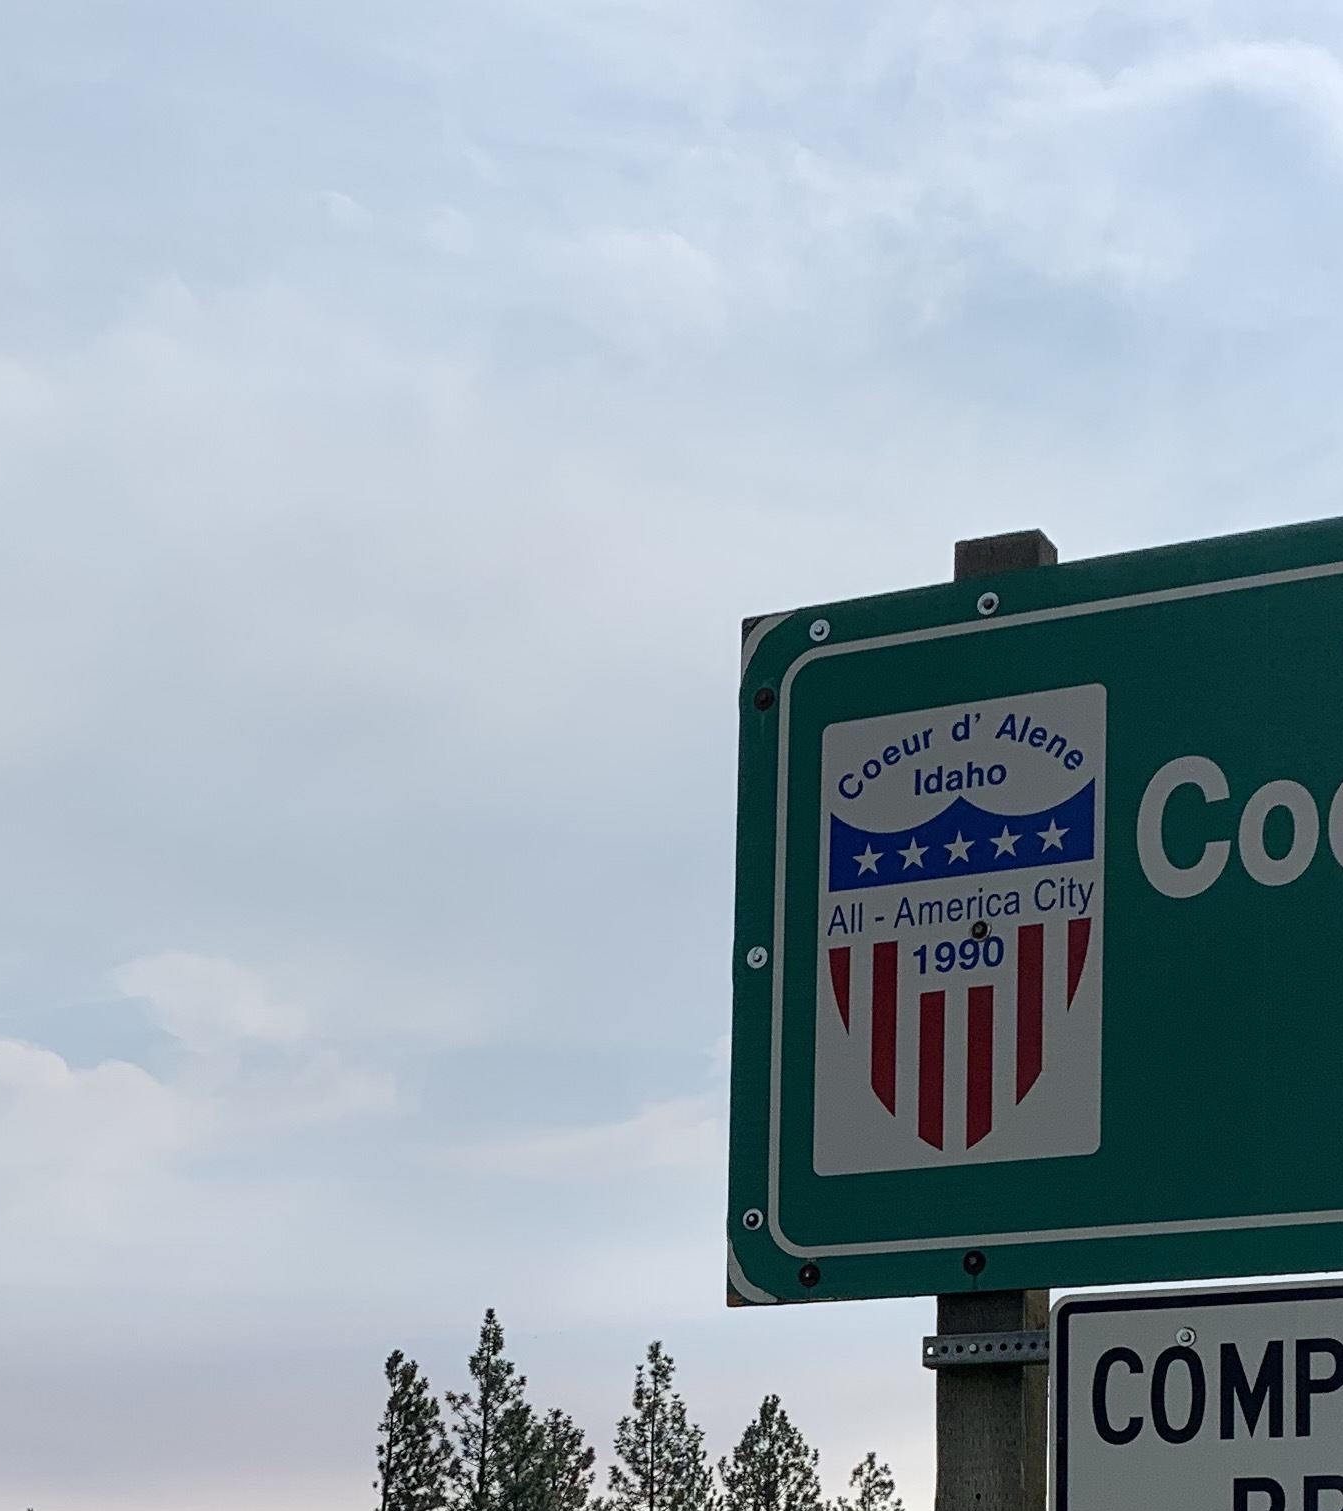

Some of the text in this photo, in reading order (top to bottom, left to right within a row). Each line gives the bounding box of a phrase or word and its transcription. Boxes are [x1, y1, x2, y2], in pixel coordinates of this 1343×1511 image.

[838, 728, 935, 800] Coeur
[995, 713, 1084, 771] Alene
[914, 761, 1007, 795] Idaho
[827, 903, 863, 936] All
[894, 887, 1020, 929] America
[1034, 877, 1094, 915] City
[912, 933, 1005, 974] 1990
